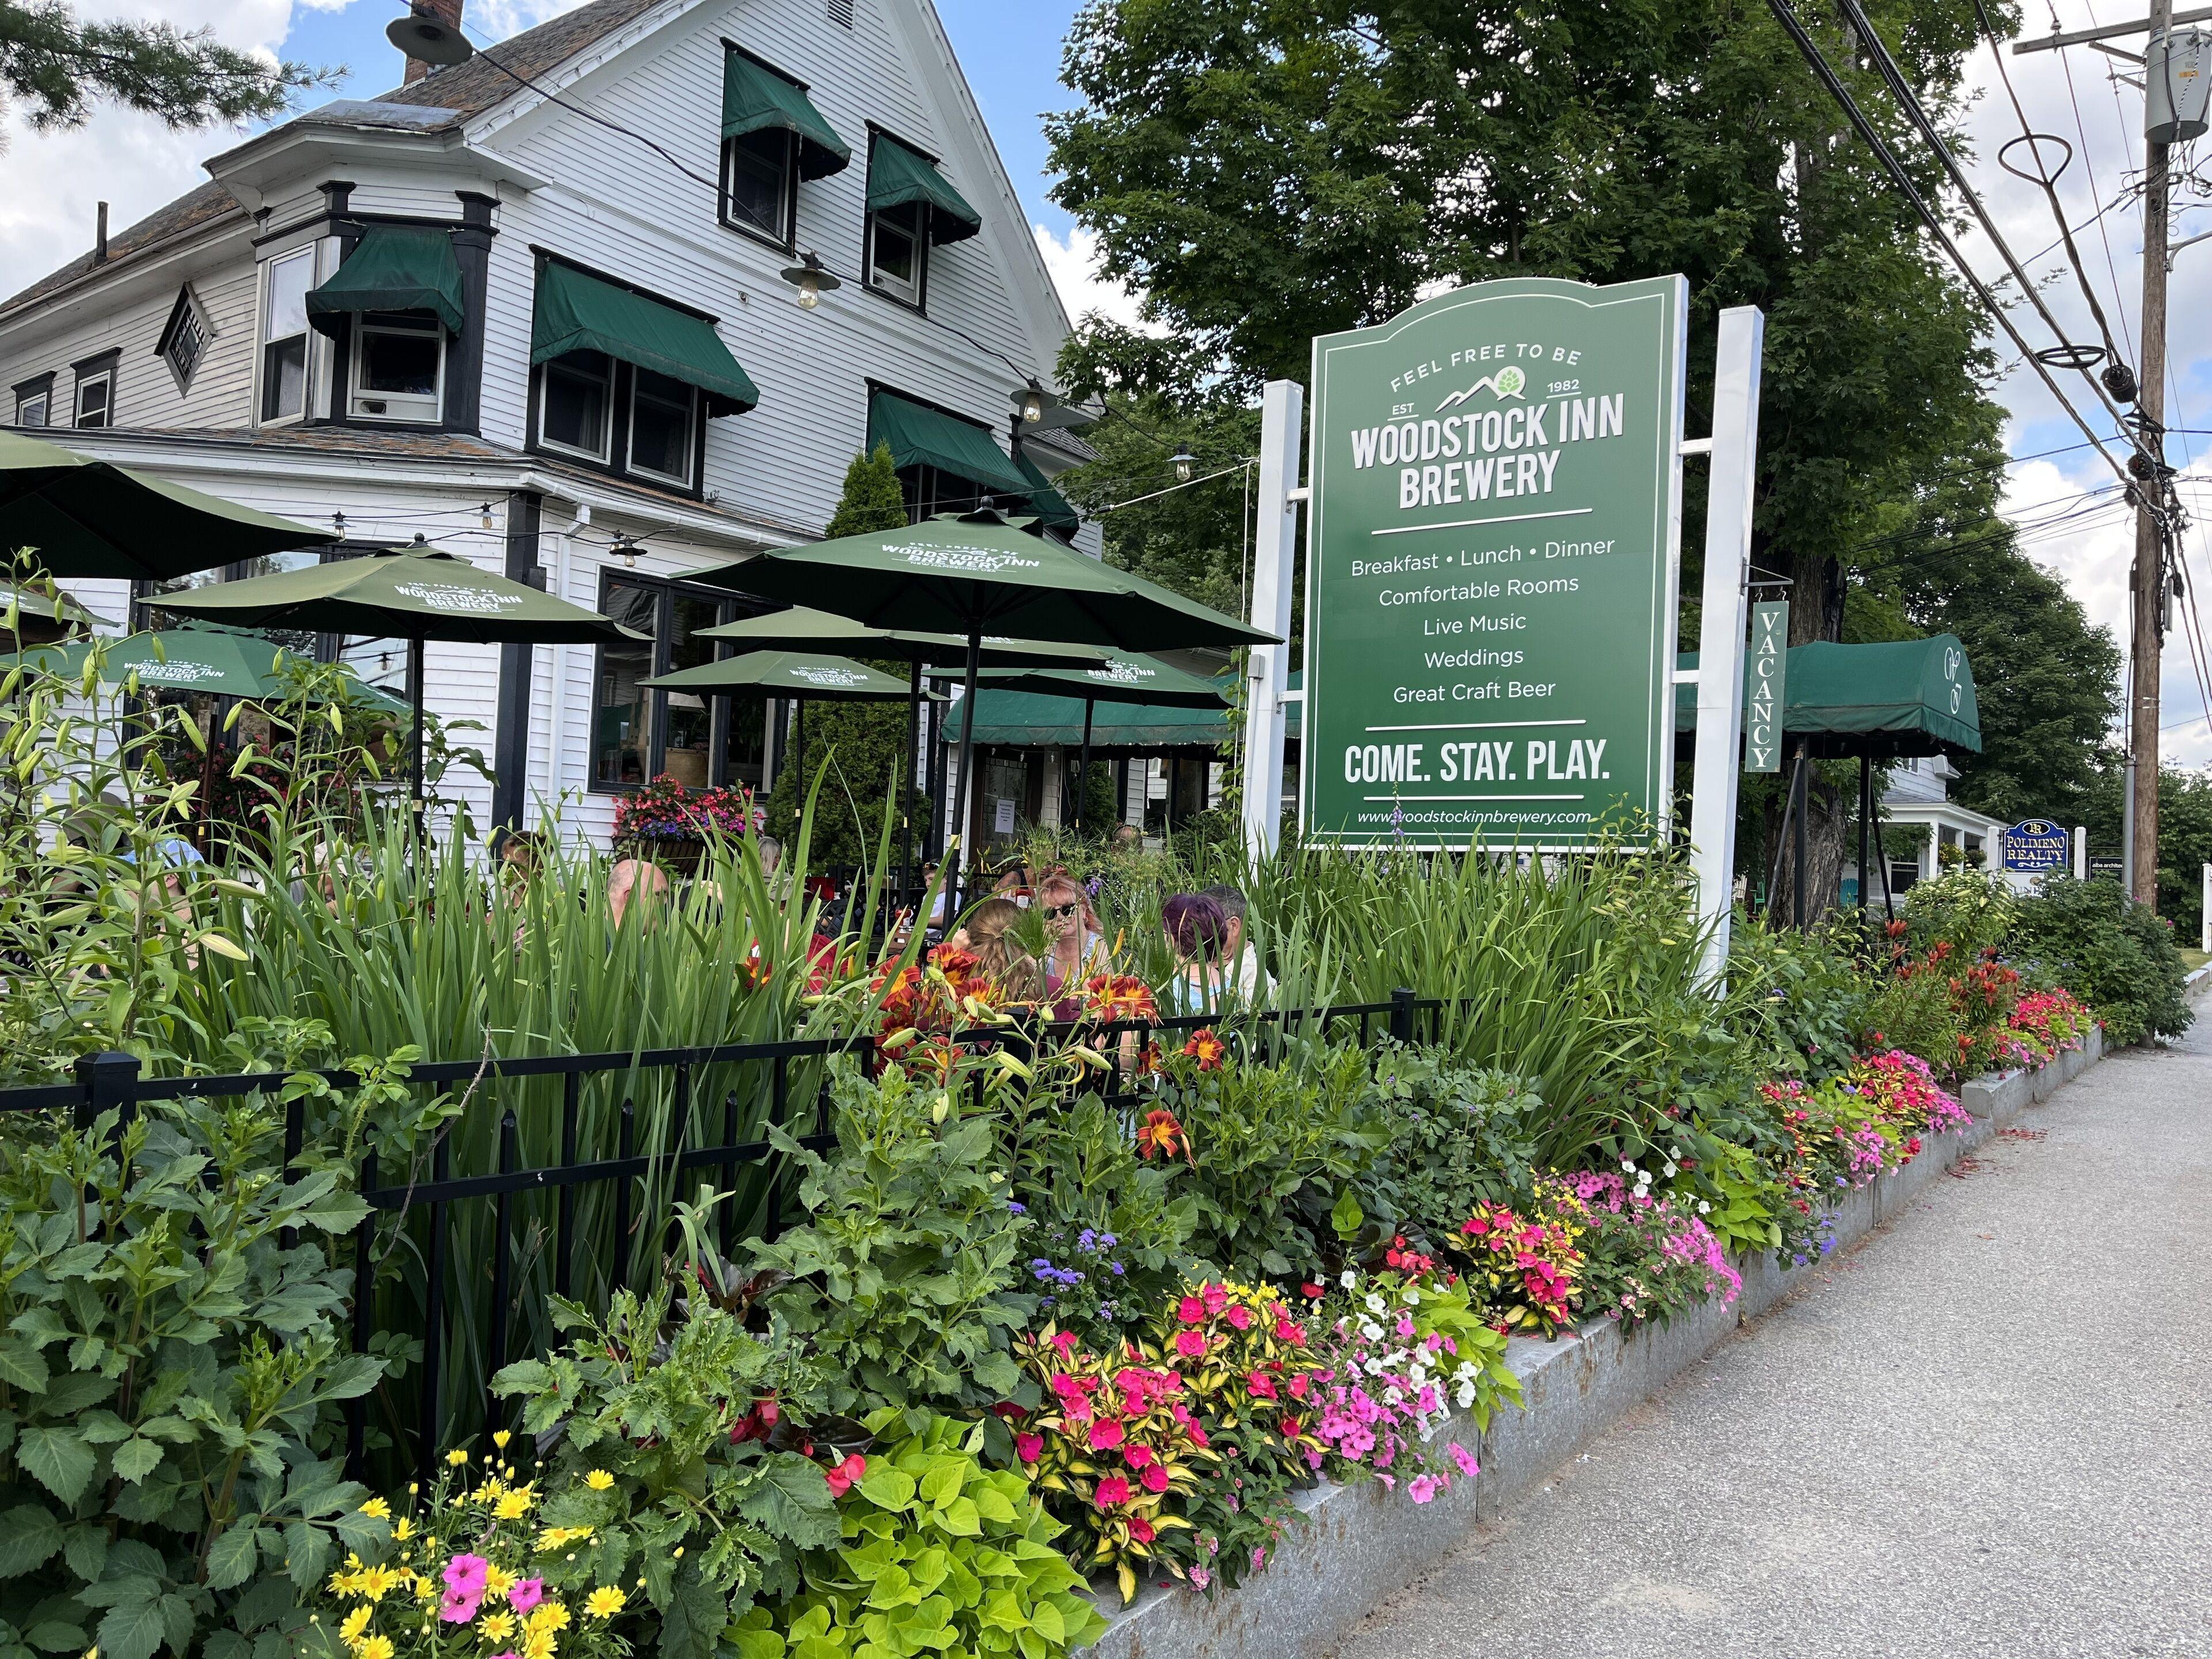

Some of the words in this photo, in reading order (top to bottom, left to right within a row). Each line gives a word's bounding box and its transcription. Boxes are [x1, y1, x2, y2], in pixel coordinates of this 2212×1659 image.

[1389, 359, 1442, 393] FEEL
[1450, 344, 1507, 366] FREE
[1517, 343, 1543, 358] TO
[1552, 347, 1582, 366] BE
[1392, 403, 1415, 415] EST
[1547, 378, 1580, 393] 1982
[1350, 403, 1549, 469] WOODSTOCK
[1558, 393, 1624, 444] INN
[1399, 449, 1561, 509] BREWERY
[882, 544, 999, 563] WOODSTOCK
[1004, 558, 1040, 567] INN
[907, 554, 1005, 570] BREWERY
[1351, 552, 1439, 577] Breakfast
[1460, 545, 1522, 567] Lunch
[1545, 538, 1616, 559] Dinner
[394, 585, 491, 603] WOODSTOCK
[492, 595, 523, 603] INN
[425, 597, 499, 609] BREWERY
[1378, 581, 1500, 607] Comfortable
[1507, 577, 1580, 596] Rooms
[1423, 618, 1463, 636] Live
[1469, 613, 1527, 632] Music
[124, 662, 199, 675] WOODSTOCK
[1424, 648, 1524, 668] Weddings
[138, 669, 200, 680] BREWERY
[789, 669, 848, 680] WOODSTOCK
[1087, 670, 1138, 681] BREWERY
[1393, 684, 1445, 703] Great
[1452, 681, 1501, 700] Craft
[1508, 680, 1556, 698] Beer
[1751, 612, 1781, 768] VACANCY
[1344, 744, 1431, 783] COME.
[1440, 741, 1516, 781] STAY.
[1527, 738, 1610, 779] PLAY.
[2006, 835, 2065, 849] POLIMENO
[2006, 849, 2065, 861] REALTY
